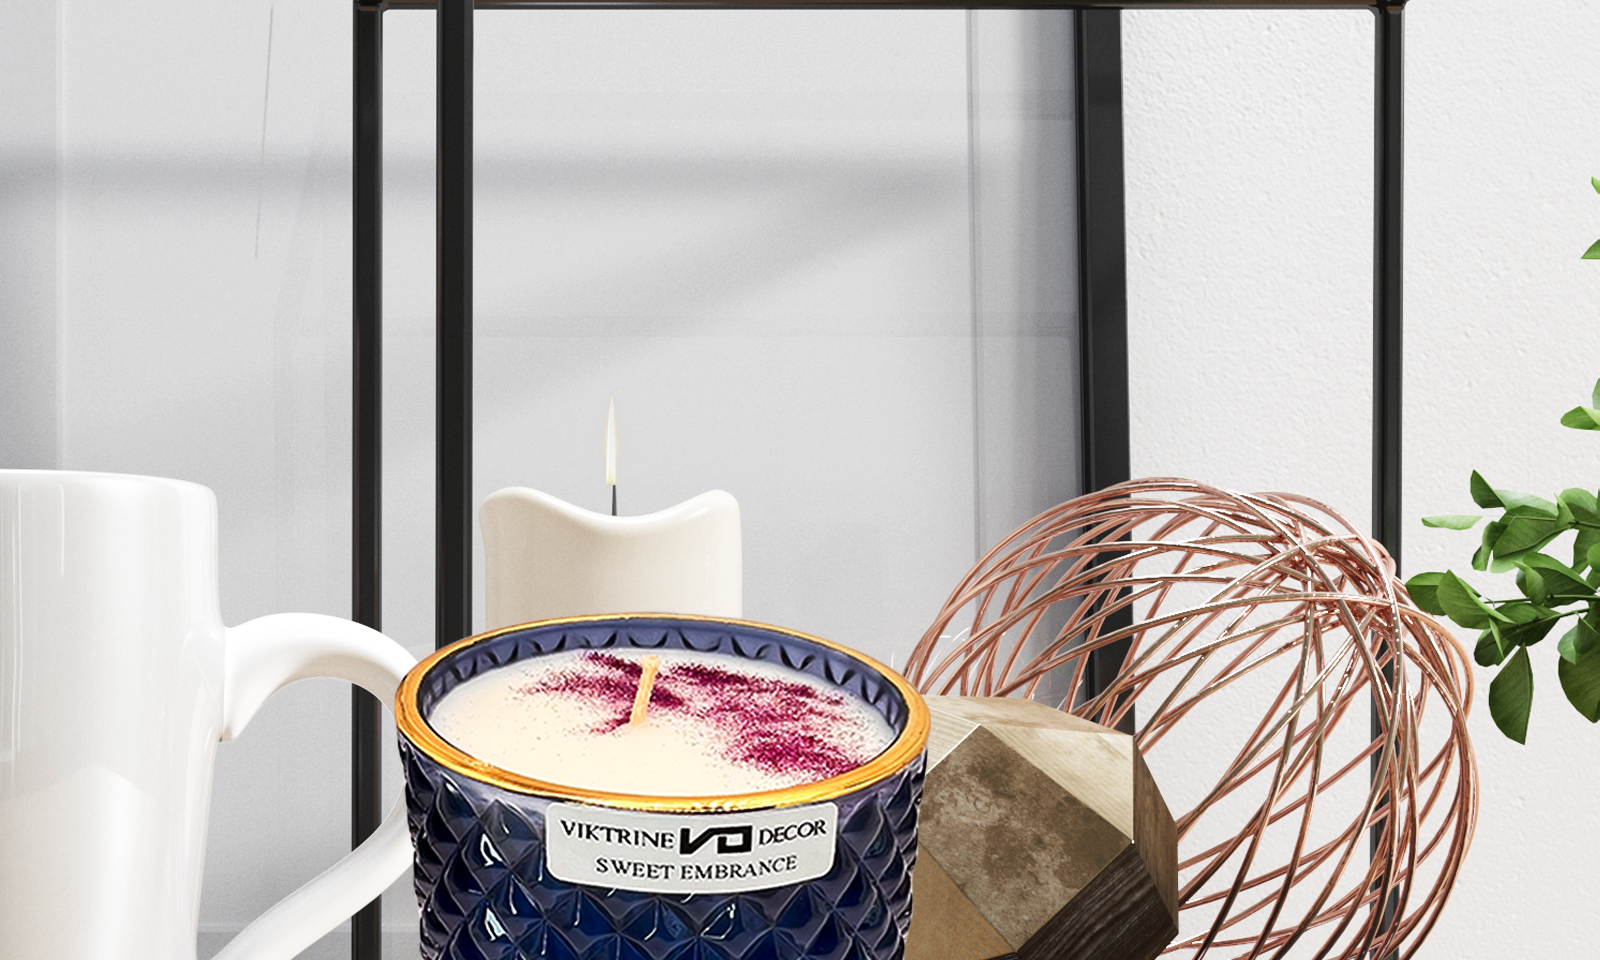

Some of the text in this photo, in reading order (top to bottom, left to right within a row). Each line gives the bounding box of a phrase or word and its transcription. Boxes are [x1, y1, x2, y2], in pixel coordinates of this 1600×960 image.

[560, 820, 676, 849] VIKTRINE
[759, 820, 827, 845] DECOR
[597, 855, 798, 880] SWEET EMBRANCE
